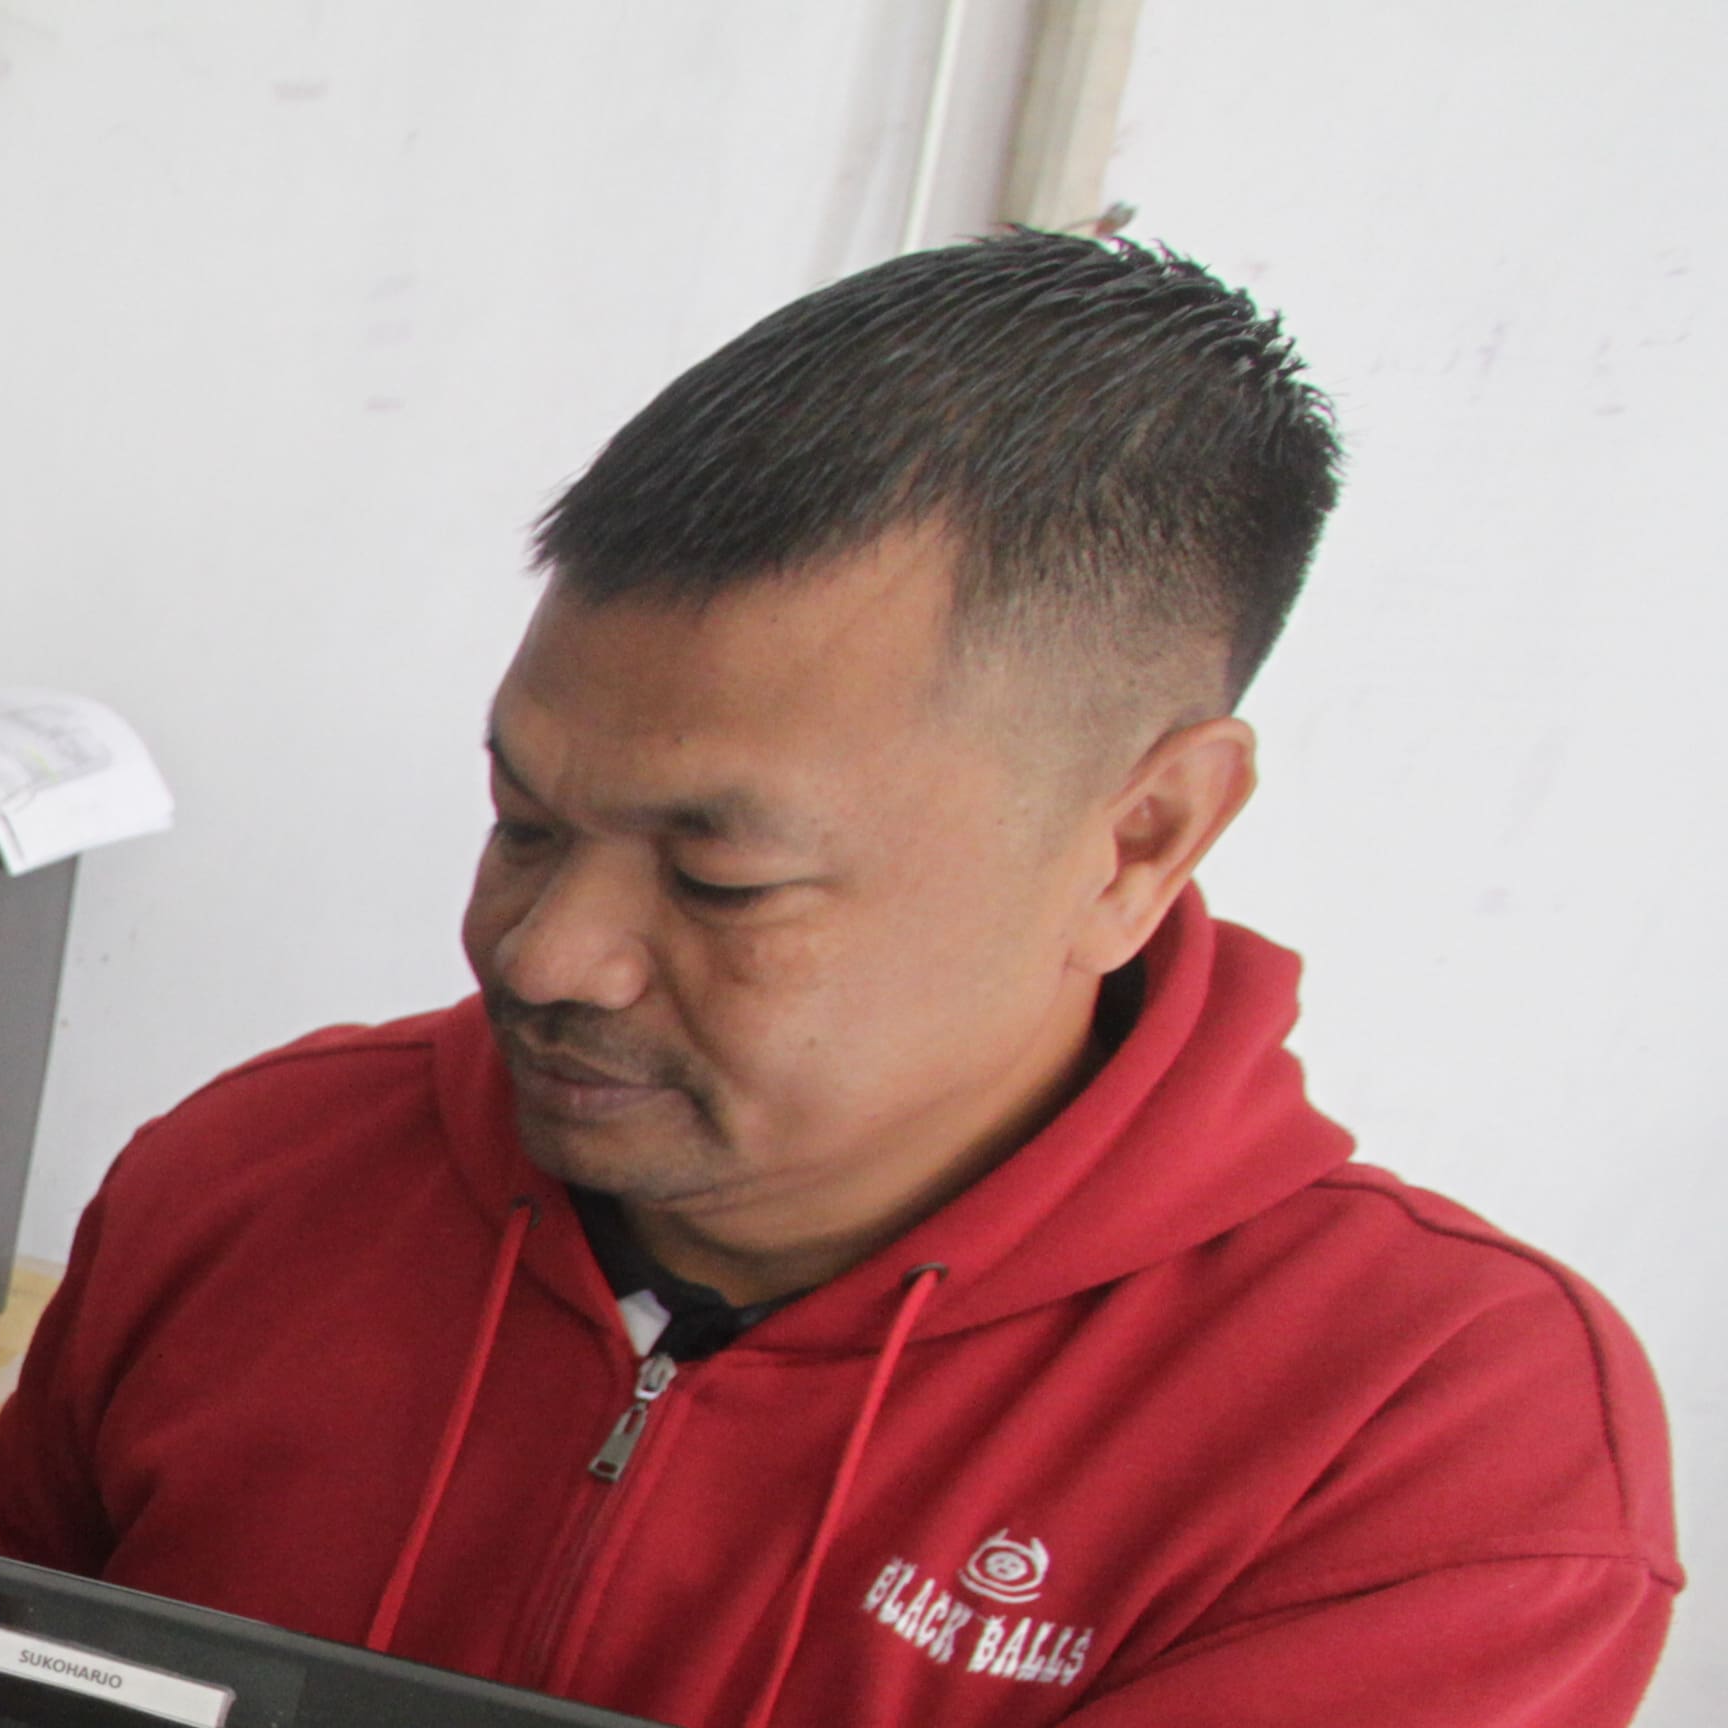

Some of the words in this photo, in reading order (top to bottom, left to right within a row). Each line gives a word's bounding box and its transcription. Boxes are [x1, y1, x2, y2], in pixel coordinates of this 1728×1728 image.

[863, 1556, 973, 1664] BLACK
[967, 1615, 1093, 1687] BALLS
[18, 1649, 123, 1689] SUKOHARJO
